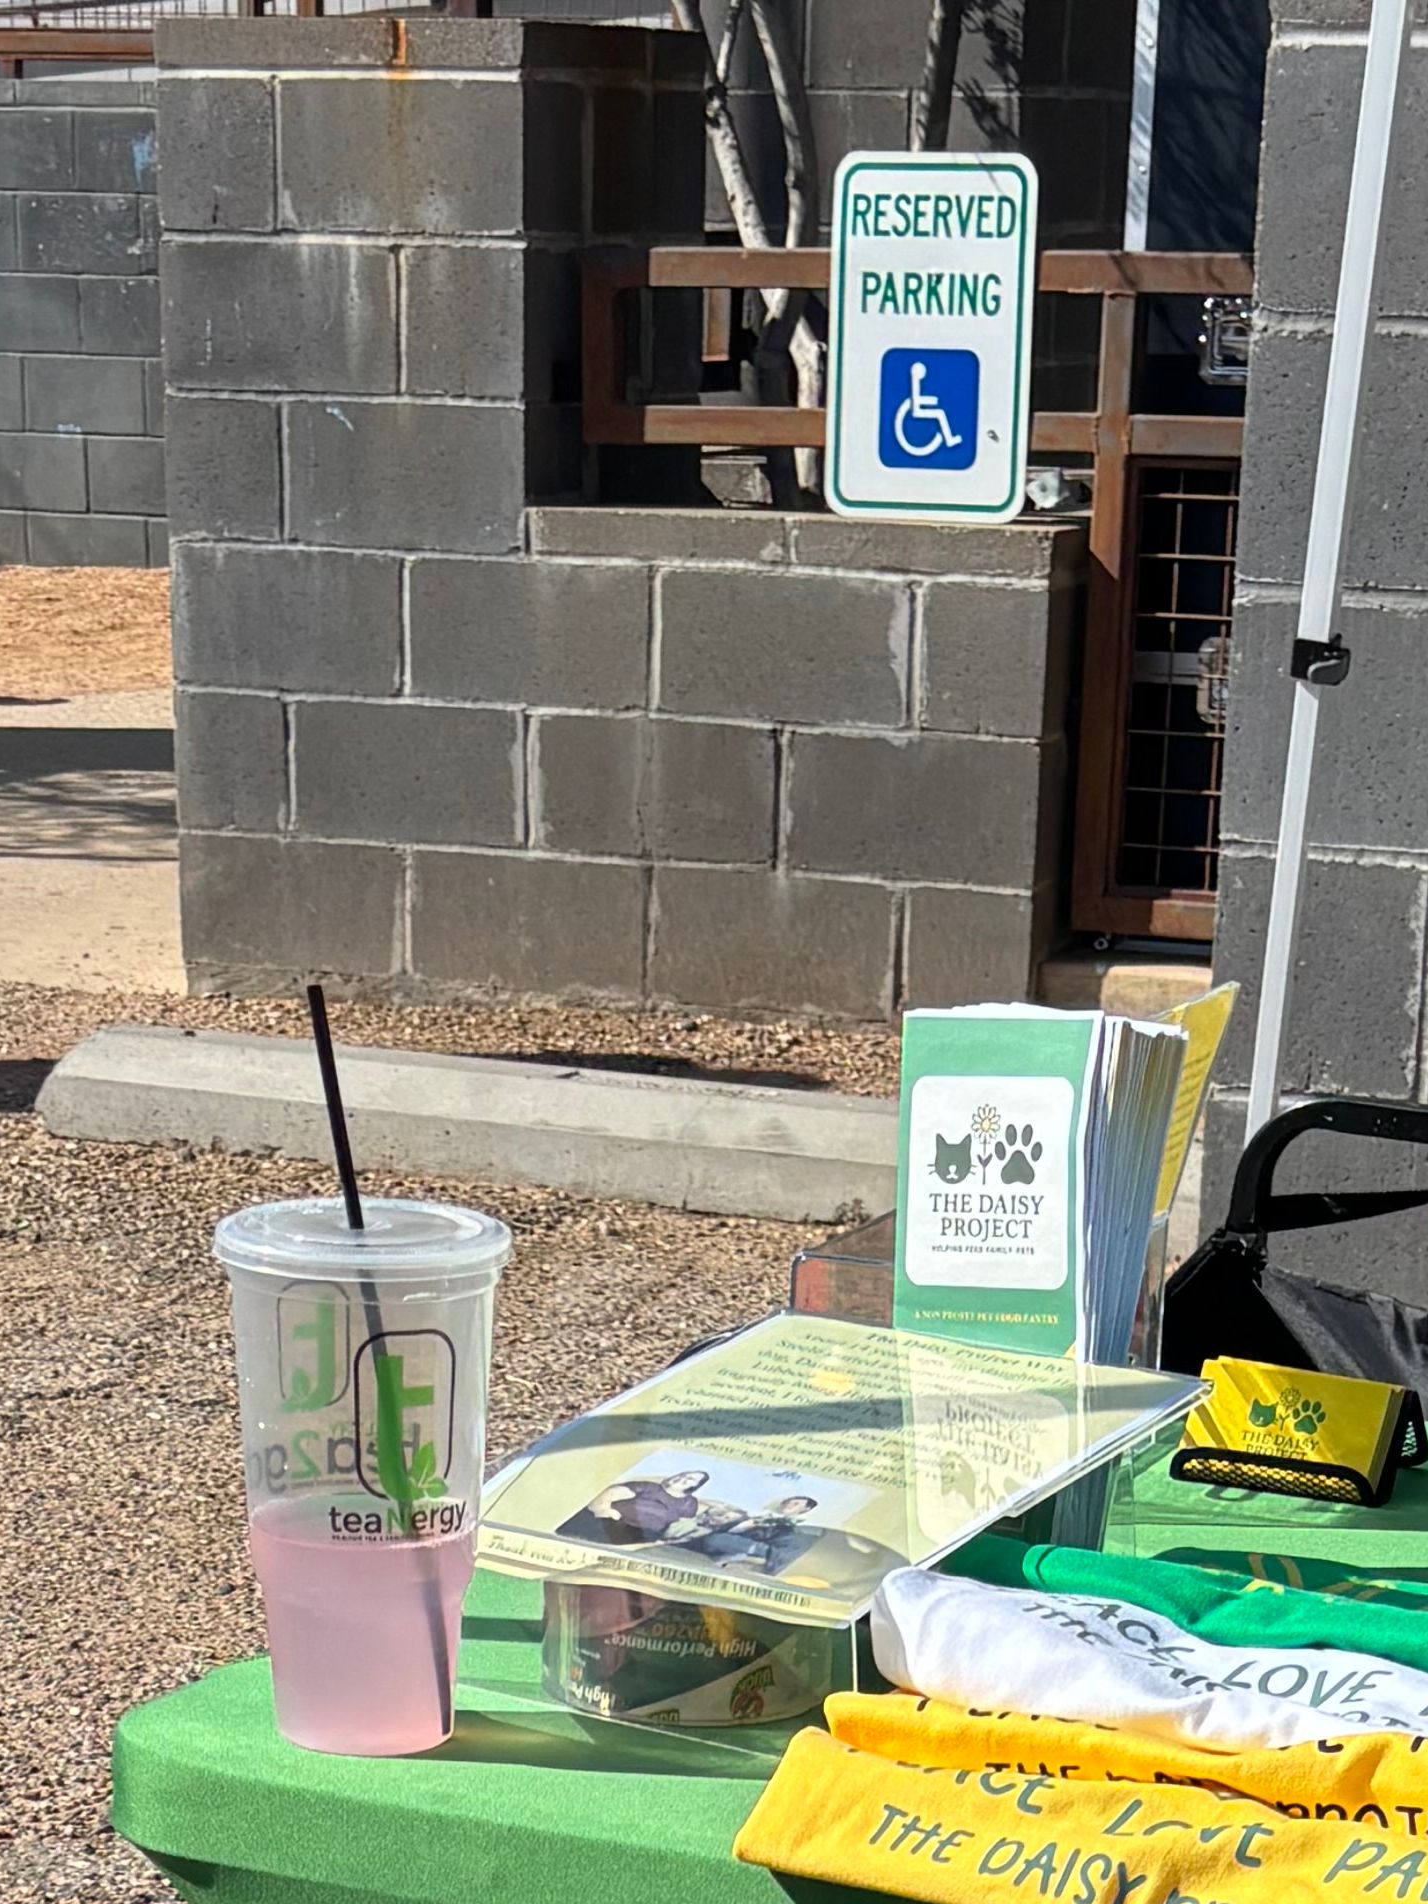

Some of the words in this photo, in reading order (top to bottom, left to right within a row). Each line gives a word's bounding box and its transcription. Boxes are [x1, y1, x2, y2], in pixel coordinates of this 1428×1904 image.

[851, 193, 1017, 239] RESERVED
[861, 271, 1002, 317] PARKING
[929, 1192, 973, 1214] THE
[978, 1193, 1045, 1217] DAISY
[939, 1216, 1033, 1243] PROJECT
[1242, 1430, 1271, 1445] THE
[1273, 1434, 1319, 1452] DAISY
[329, 1500, 467, 1535] teaNergy
[1222, 1659, 1394, 1709] LOVE
[868, 1803, 975, 1865] THE
